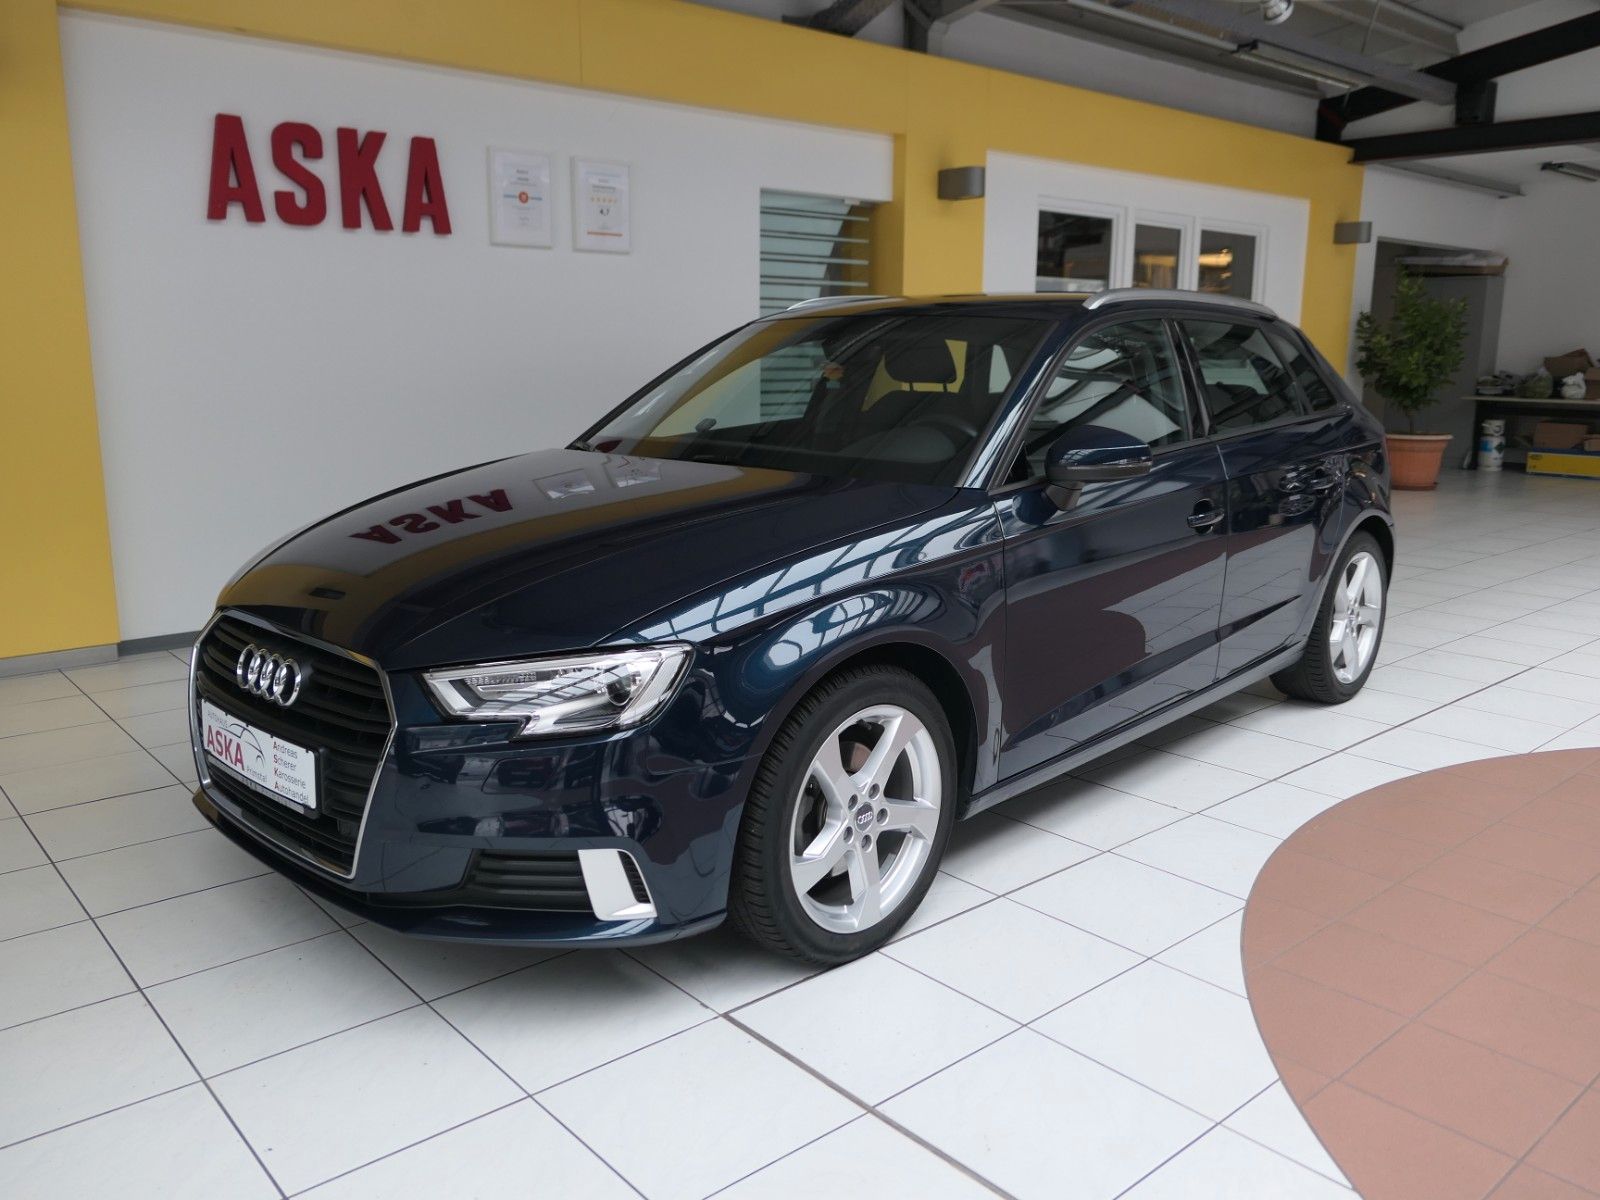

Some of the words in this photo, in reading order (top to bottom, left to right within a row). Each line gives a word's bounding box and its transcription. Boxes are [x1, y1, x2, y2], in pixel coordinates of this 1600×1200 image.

[207, 113, 452, 235] ASKA
[206, 724, 246, 772] ASKA
[273, 741, 298, 760] Andreas
[273, 754, 298, 772] Scherer
[273, 767, 307, 790] Karosserie
[274, 781, 310, 803] Autohandel
